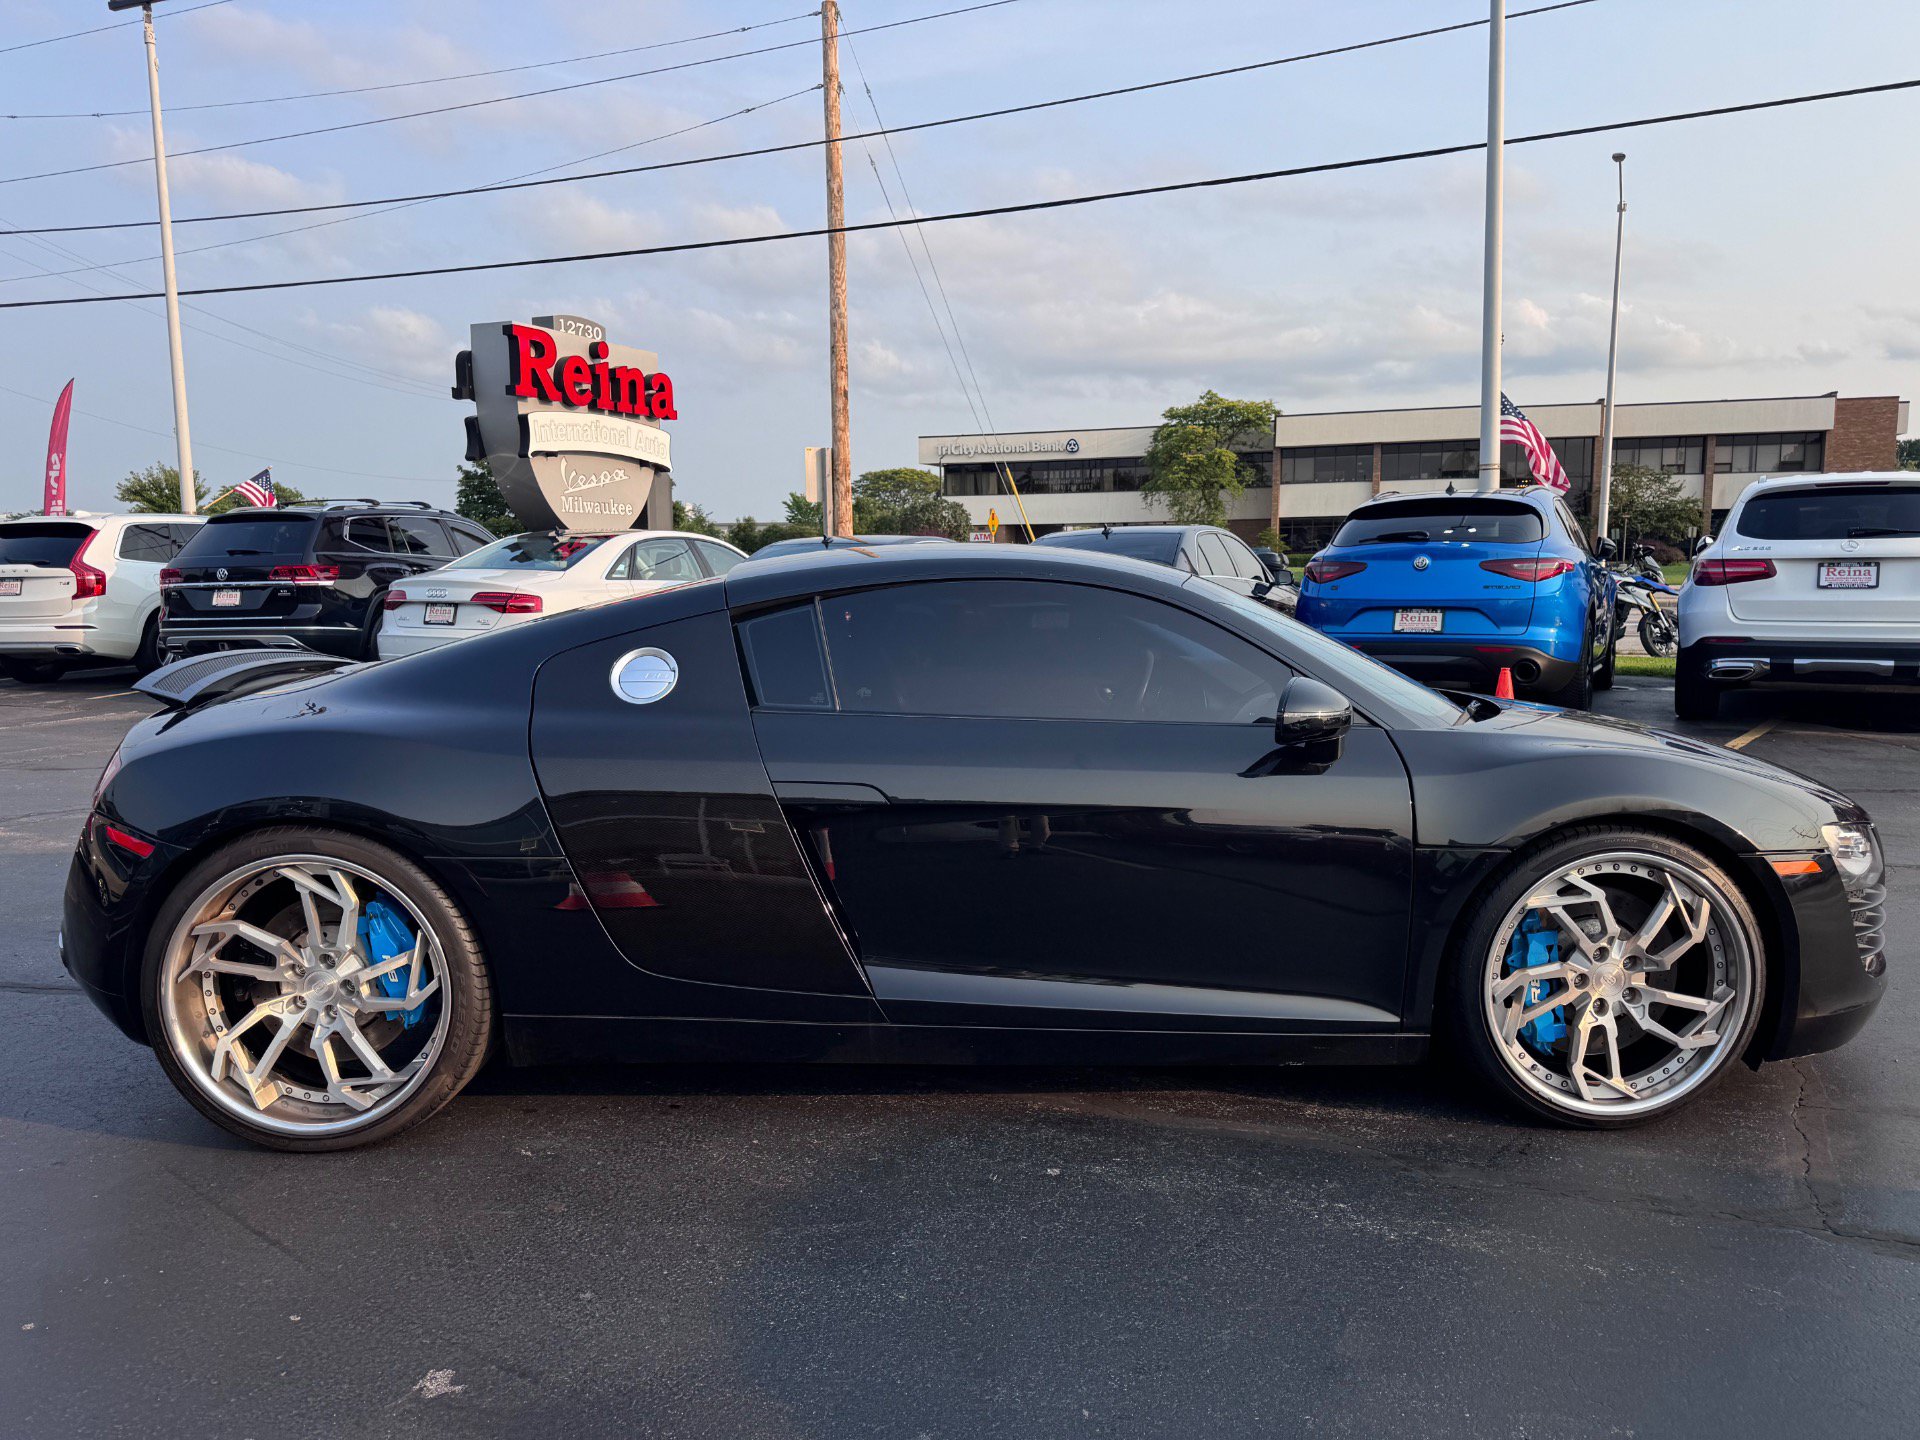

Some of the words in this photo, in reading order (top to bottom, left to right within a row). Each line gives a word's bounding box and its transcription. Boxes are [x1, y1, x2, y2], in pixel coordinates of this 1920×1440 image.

[559, 318, 603, 341] 12730
[511, 324, 678, 420] Reina
[533, 419, 632, 448] International
[635, 429, 668, 460] Auto
[979, 441, 1030, 455] National
[1032, 440, 1065, 452] Bank
[560, 456, 630, 494] Vespa
[560, 496, 633, 516] Milwaukee
[1826, 567, 1872, 577] Reina
[429, 607, 452, 616] Reina
[1400, 613, 1438, 623] Reina
